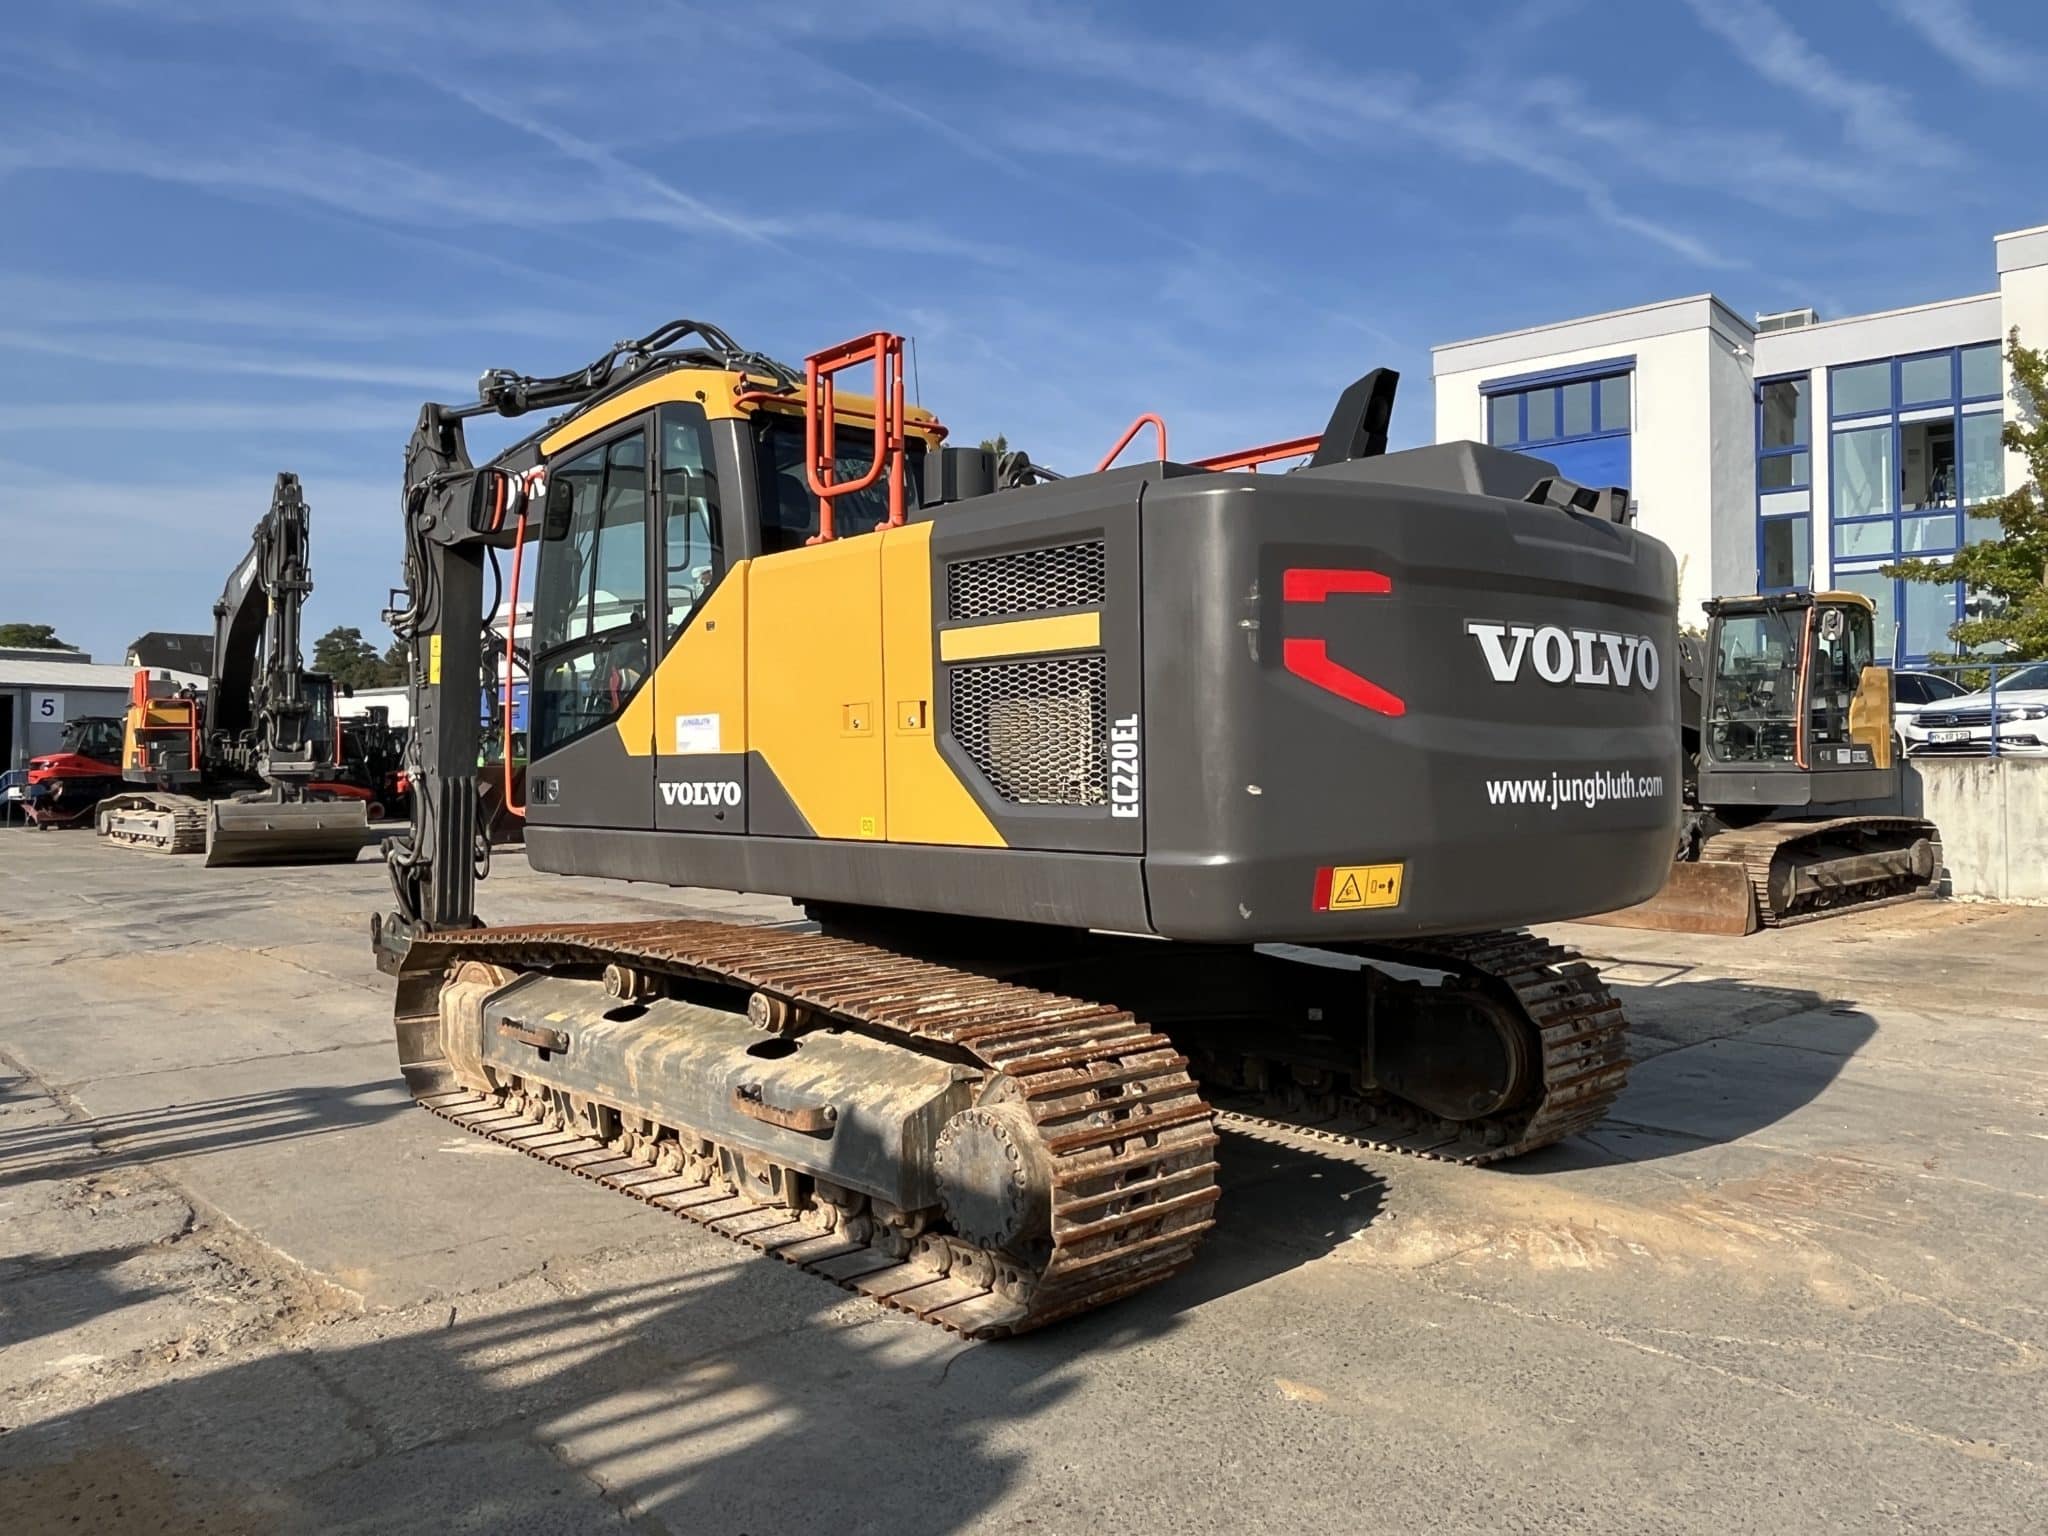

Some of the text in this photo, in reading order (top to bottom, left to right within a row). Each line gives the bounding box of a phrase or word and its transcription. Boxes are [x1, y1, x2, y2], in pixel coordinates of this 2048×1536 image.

[1467, 623, 1660, 691] VOLVO
[41, 698, 54, 716] 5
[1111, 714, 1138, 817] EC220EL
[659, 781, 742, 806] VOLVO
[1486, 770, 1663, 810] www.jungbluth.com
